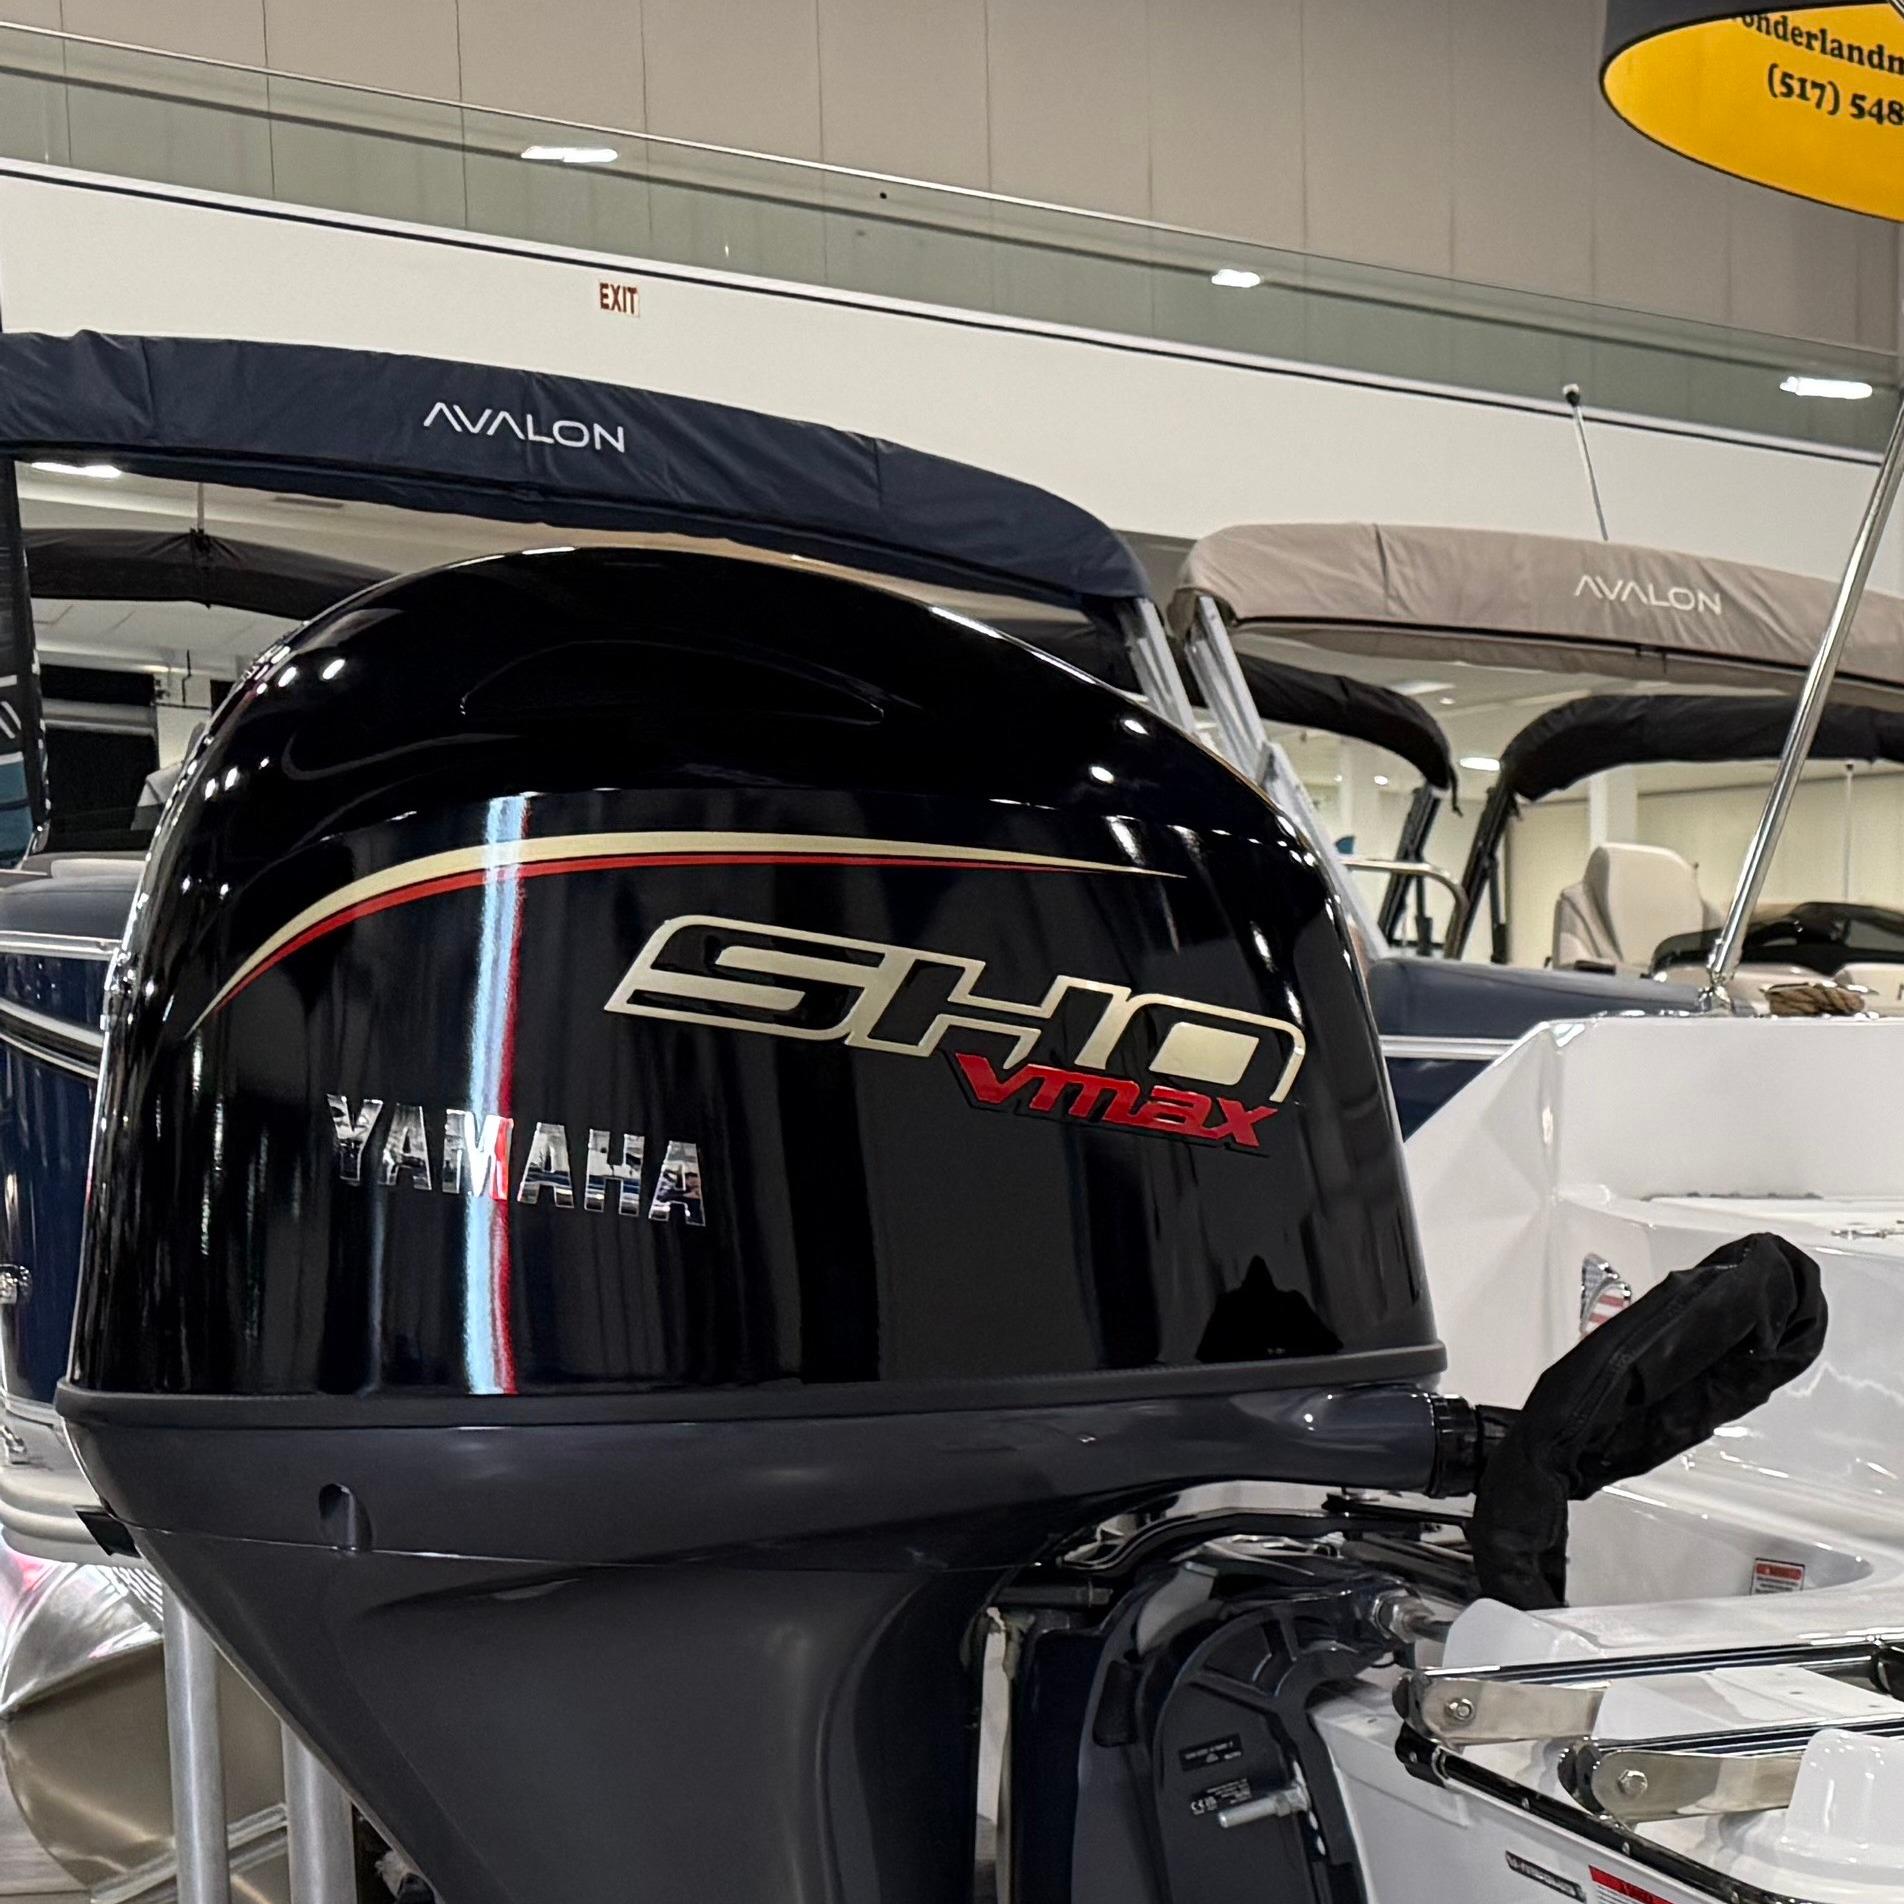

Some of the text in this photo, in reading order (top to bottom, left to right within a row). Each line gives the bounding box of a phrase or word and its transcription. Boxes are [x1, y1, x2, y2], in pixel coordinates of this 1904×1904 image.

[1767, 62, 1841, 116] (517)
[599, 282, 638, 315] EXIT
[422, 401, 626, 454] AVALON
[1573, 573, 1723, 616] AVALON
[603, 912, 1307, 1104] SHO
[326, 1092, 707, 1228] YAMAHA
